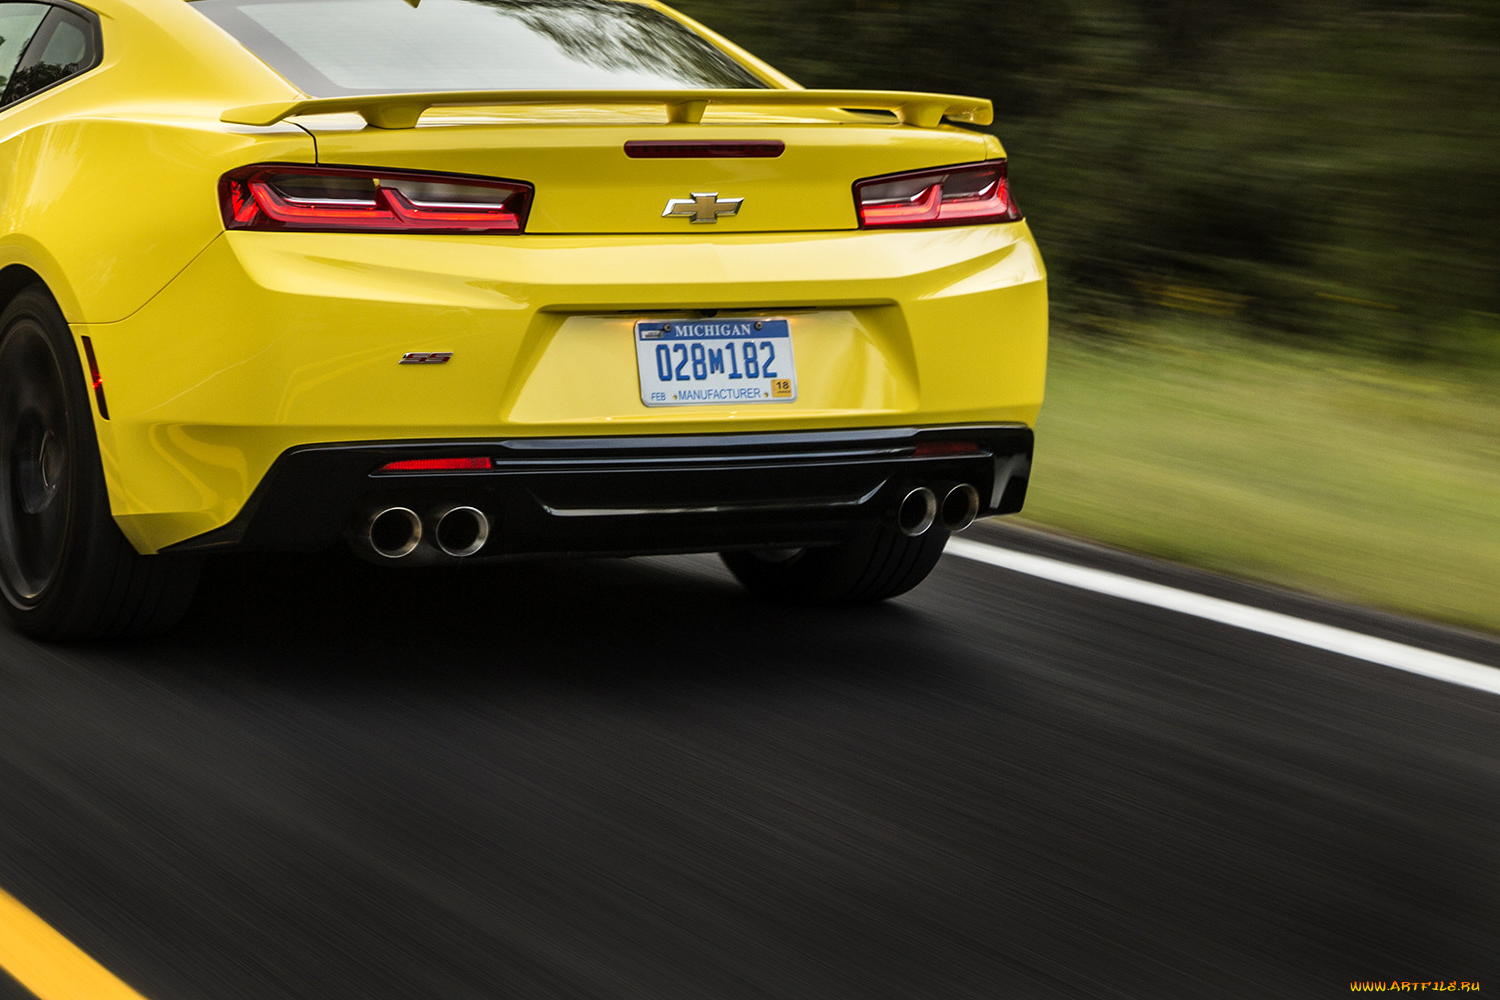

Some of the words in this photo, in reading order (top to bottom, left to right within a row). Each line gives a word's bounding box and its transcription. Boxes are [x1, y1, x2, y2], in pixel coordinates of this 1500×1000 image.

[675, 324, 751, 337] MICHIGAN
[398, 351, 454, 364] SS
[655, 341, 778, 381] 028M182
[776, 381, 790, 390] 18
[651, 392, 667, 401] FEB
[678, 388, 761, 400] MANUFACTURER
